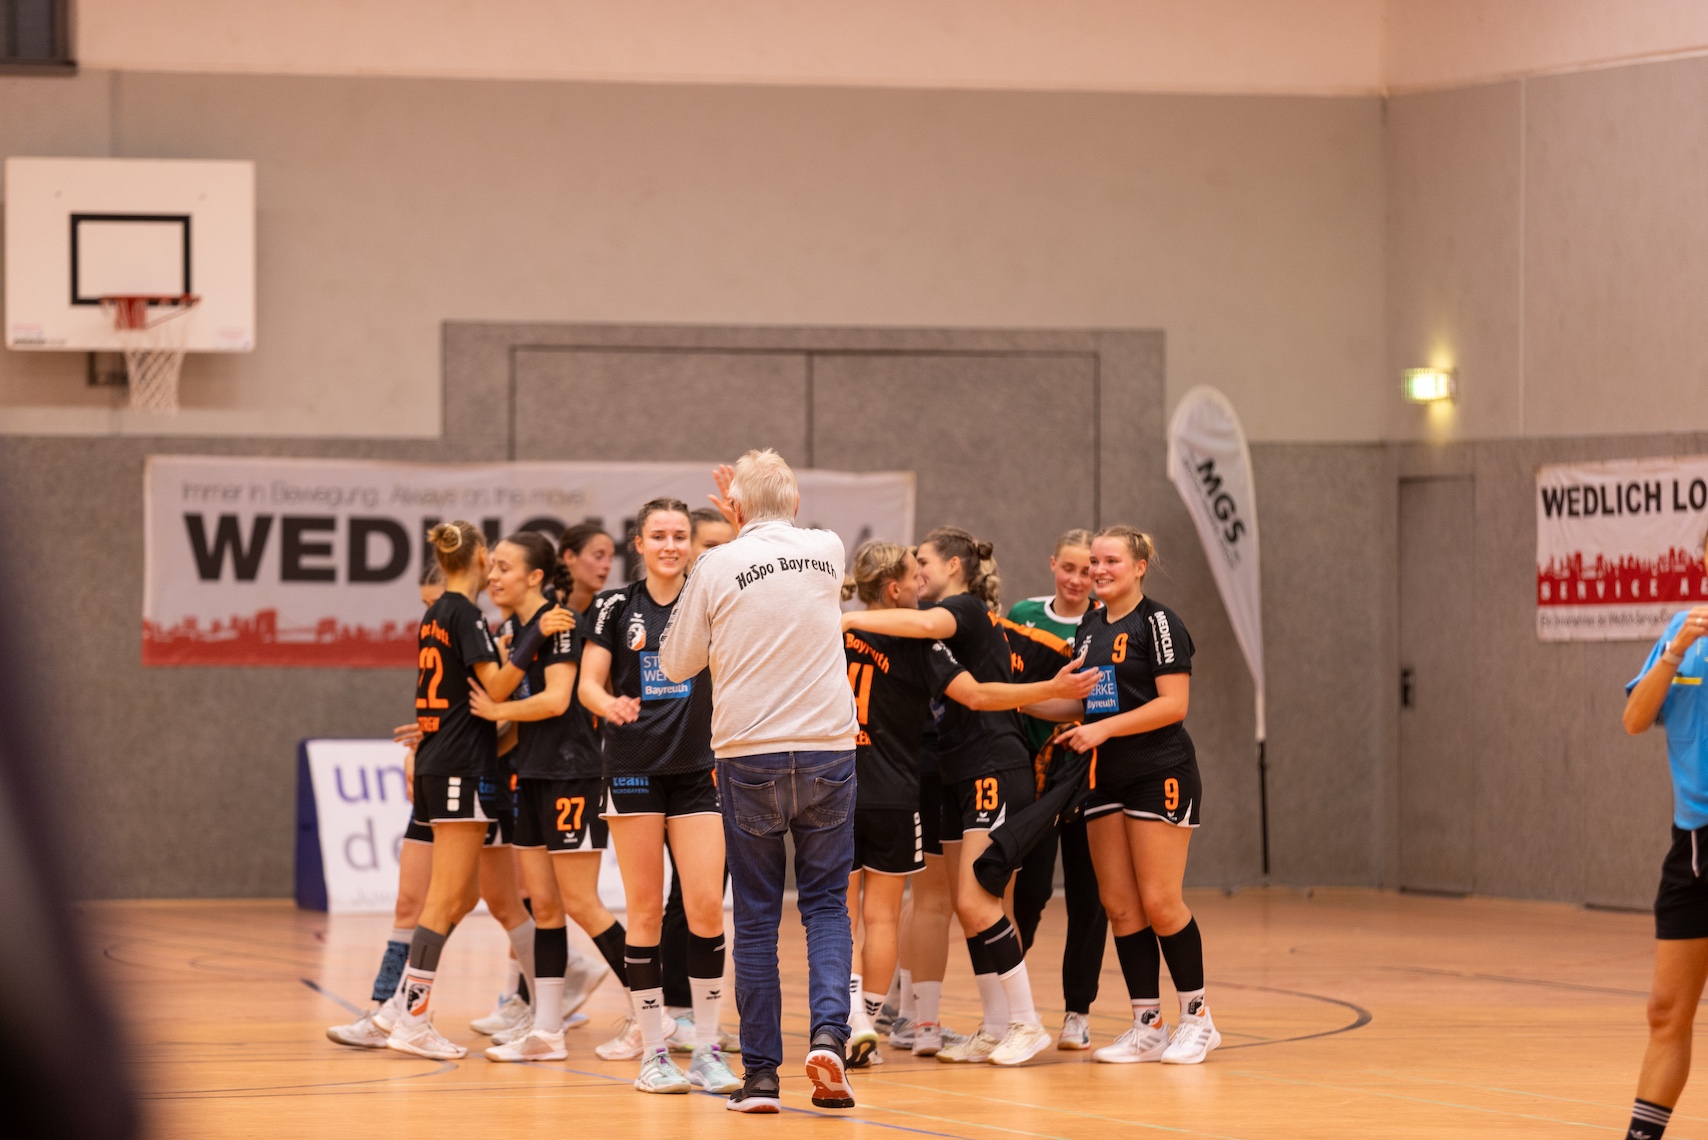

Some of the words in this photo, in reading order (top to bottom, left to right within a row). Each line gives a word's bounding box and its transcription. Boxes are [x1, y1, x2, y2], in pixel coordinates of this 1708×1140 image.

[1195, 456, 1248, 546] MGS
[1541, 480, 1662, 518] WEDLICH
[735, 563, 775, 591] HaSpo
[777, 556, 837, 580] Bayreuth
[1111, 632, 1129, 664] 9
[644, 684, 689, 696] Bayreuth
[612, 776, 649, 787] team
[975, 777, 999, 811] 13
[1164, 777, 1179, 811] 9
[555, 796, 585, 831] 27
